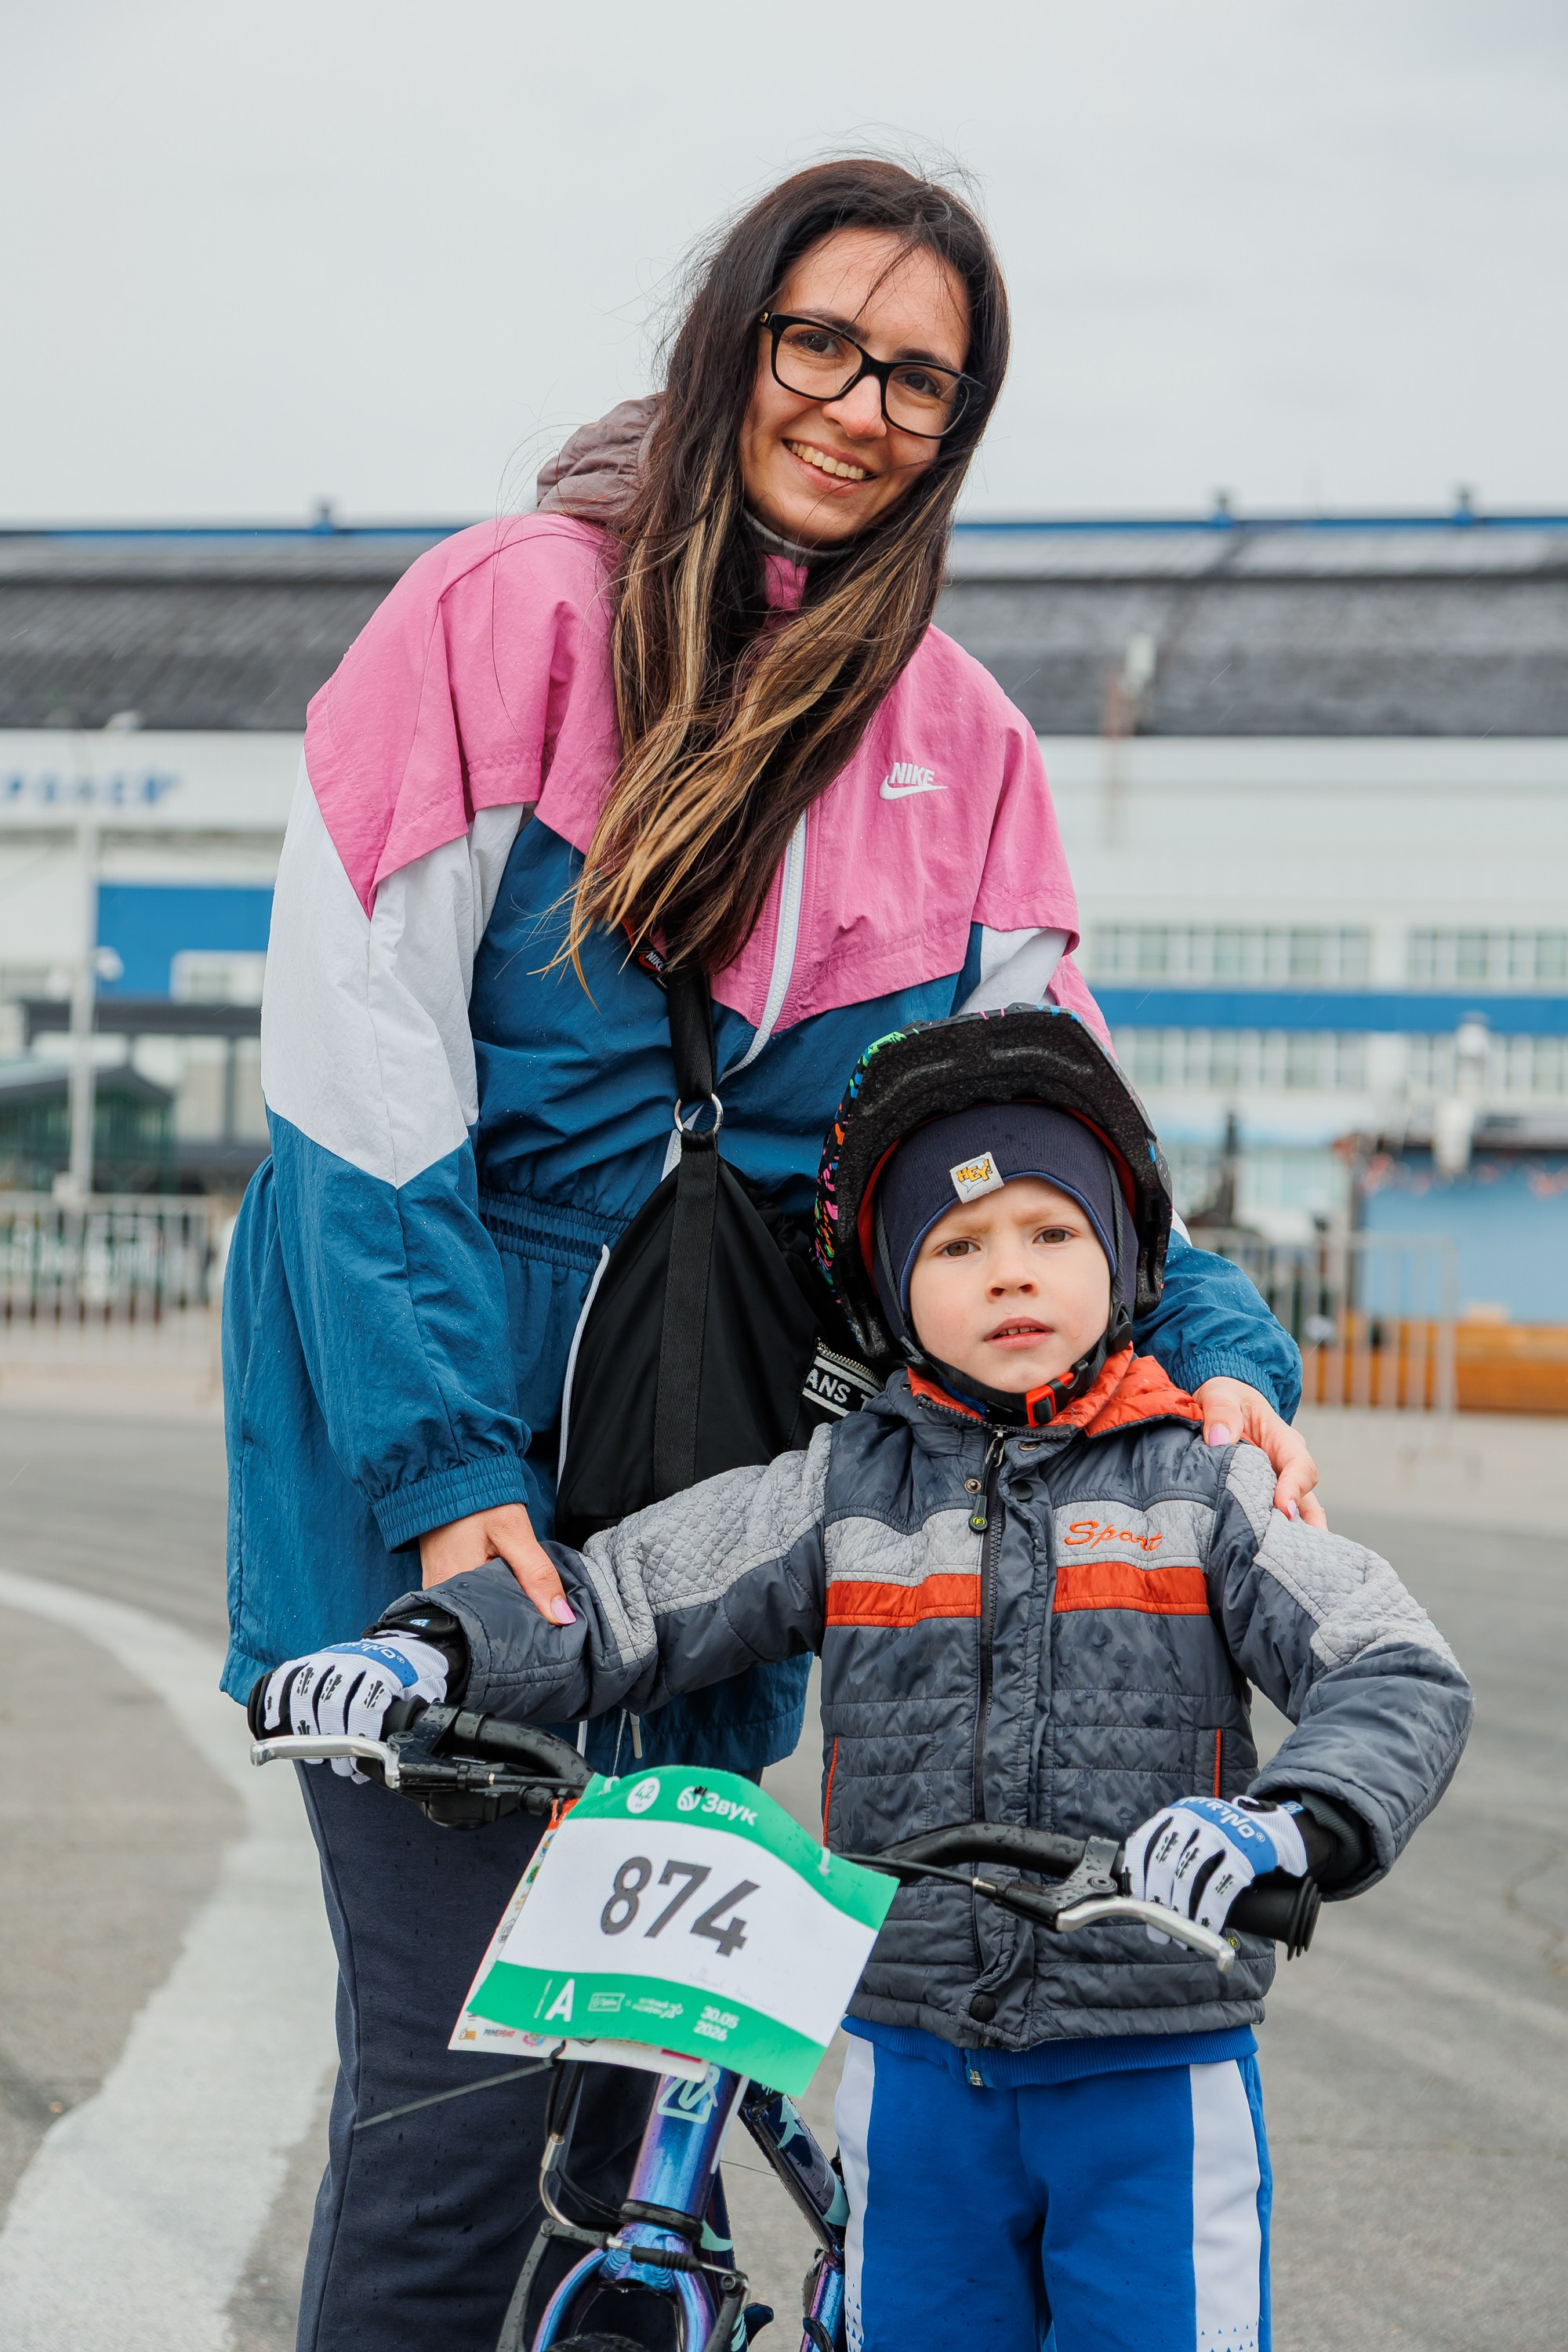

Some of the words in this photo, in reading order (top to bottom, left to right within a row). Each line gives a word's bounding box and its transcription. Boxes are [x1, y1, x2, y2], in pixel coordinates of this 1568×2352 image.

[889, 762, 935, 786] NIKE
[645, 952, 665, 971] NIKE
[956, 1159, 993, 1183] HEY!
[805, 1368, 851, 1403] ANS
[1064, 1520, 1163, 1552] Sport
[701, 1792, 758, 1826] Звук
[601, 1856, 761, 1958] 874
[700, 2005, 740, 2029] 30.05
